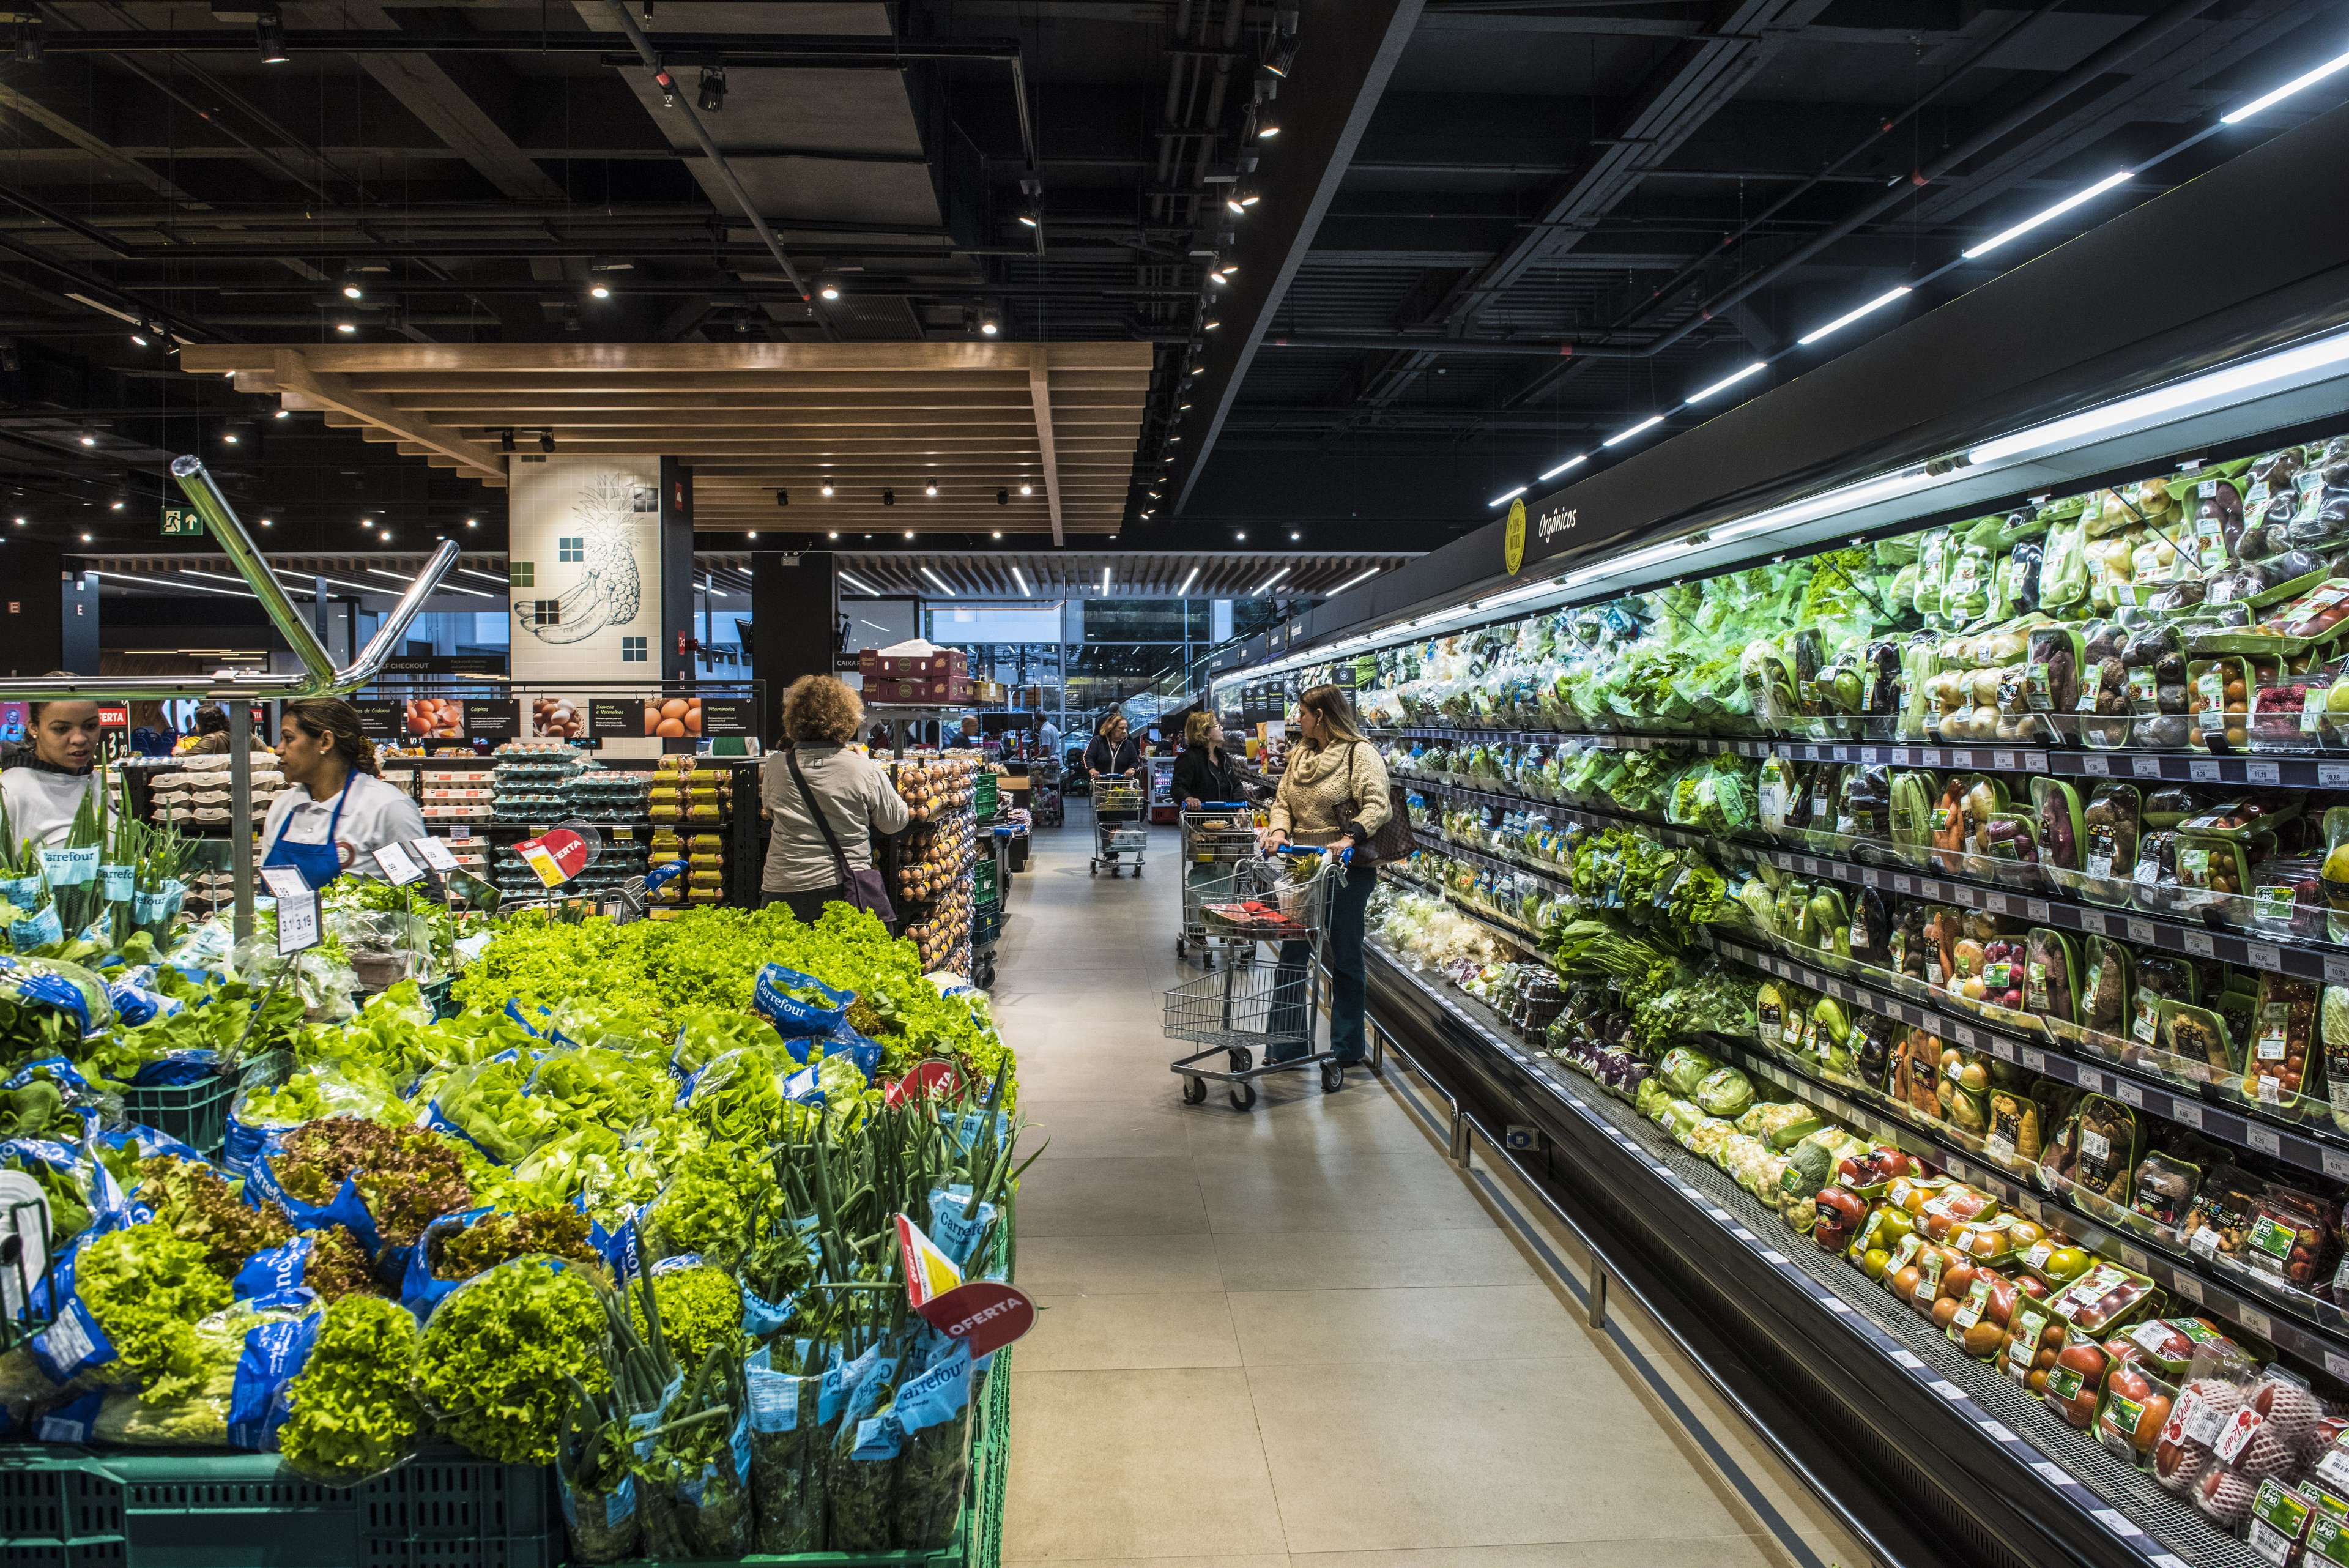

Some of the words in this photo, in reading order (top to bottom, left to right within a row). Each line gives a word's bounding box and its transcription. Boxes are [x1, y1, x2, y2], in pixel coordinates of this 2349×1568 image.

[1538, 506, 1577, 543] Orgânicos
[552, 839, 582, 860] FERTA
[97, 868, 133, 879] Carrefo
[135, 896, 166, 905] refour
[283, 919, 293, 933] 3,1
[297, 915, 311, 931] 3,19
[2331, 968, 2347, 977] 10,89
[759, 979, 806, 1017] Carrefour
[2254, 1135, 2265, 1145] 8,29
[2330, 1162, 2342, 1171] 6,79
[251, 1154, 299, 1222] Carrefour
[2140, 1189, 2164, 1202] ORGÂNICO
[941, 1211, 984, 1236] Carrefo
[2274, 1225, 2295, 1238] ORGÂNICO
[905, 1244, 918, 1284] OFERTA
[949, 1297, 1023, 1336] OFERTA
[2246, 1316, 2258, 1326] 10,99
[2062, 1368, 2082, 1380] ORGÂNICO
[2333, 1365, 2345, 1374] 7,39
[902, 1360, 966, 1401] arrefour
[2121, 1399, 2142, 1411] ORGÂNICO
[2176, 1393, 2192, 1426] Rubi
[2222, 1424, 2243, 1456] Rubi
[2282, 1496, 2307, 1515] ORGÂNICO
[2322, 1495, 2348, 1512] ORGÂNICO
